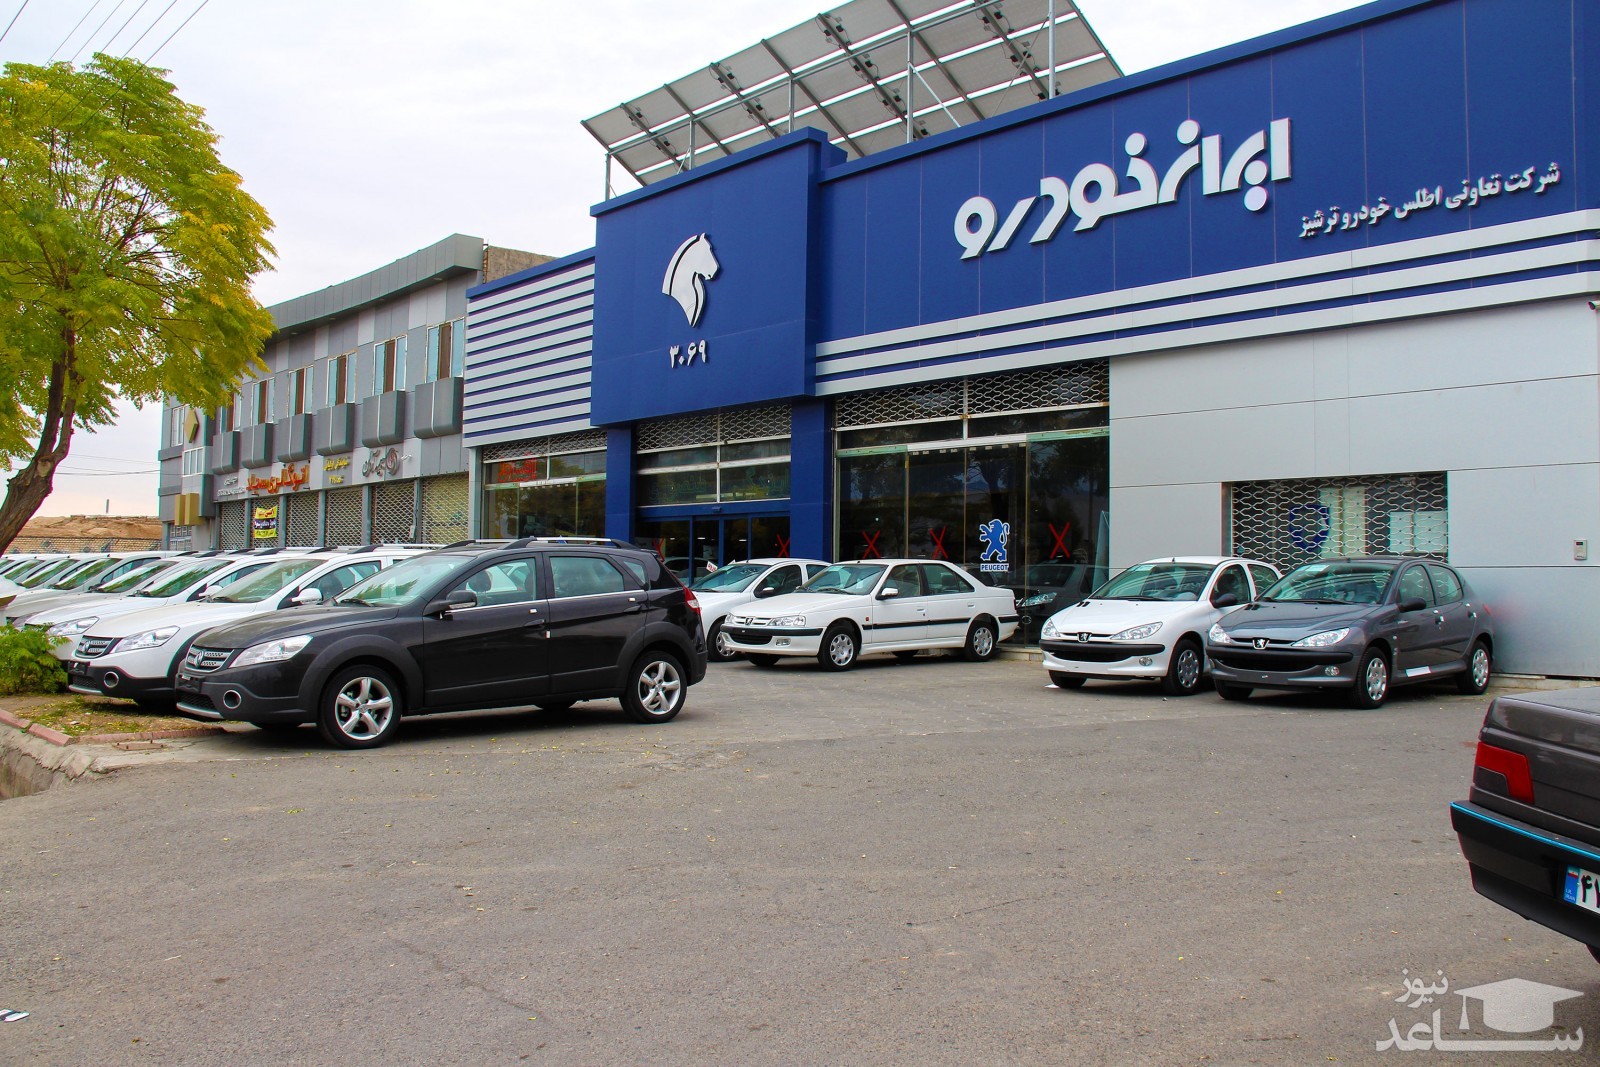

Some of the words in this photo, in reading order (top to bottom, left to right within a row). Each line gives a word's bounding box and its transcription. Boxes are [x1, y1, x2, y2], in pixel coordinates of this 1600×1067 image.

[1444, 173, 1502, 209] تعاونی
[1503, 161, 1561, 194] شرکت
[1340, 196, 1392, 230] خودرو
[1394, 185, 1443, 219] اطلس
[1298, 205, 1340, 238] ترشیز
[669, 339, 707, 369] ۳۰۶۹
